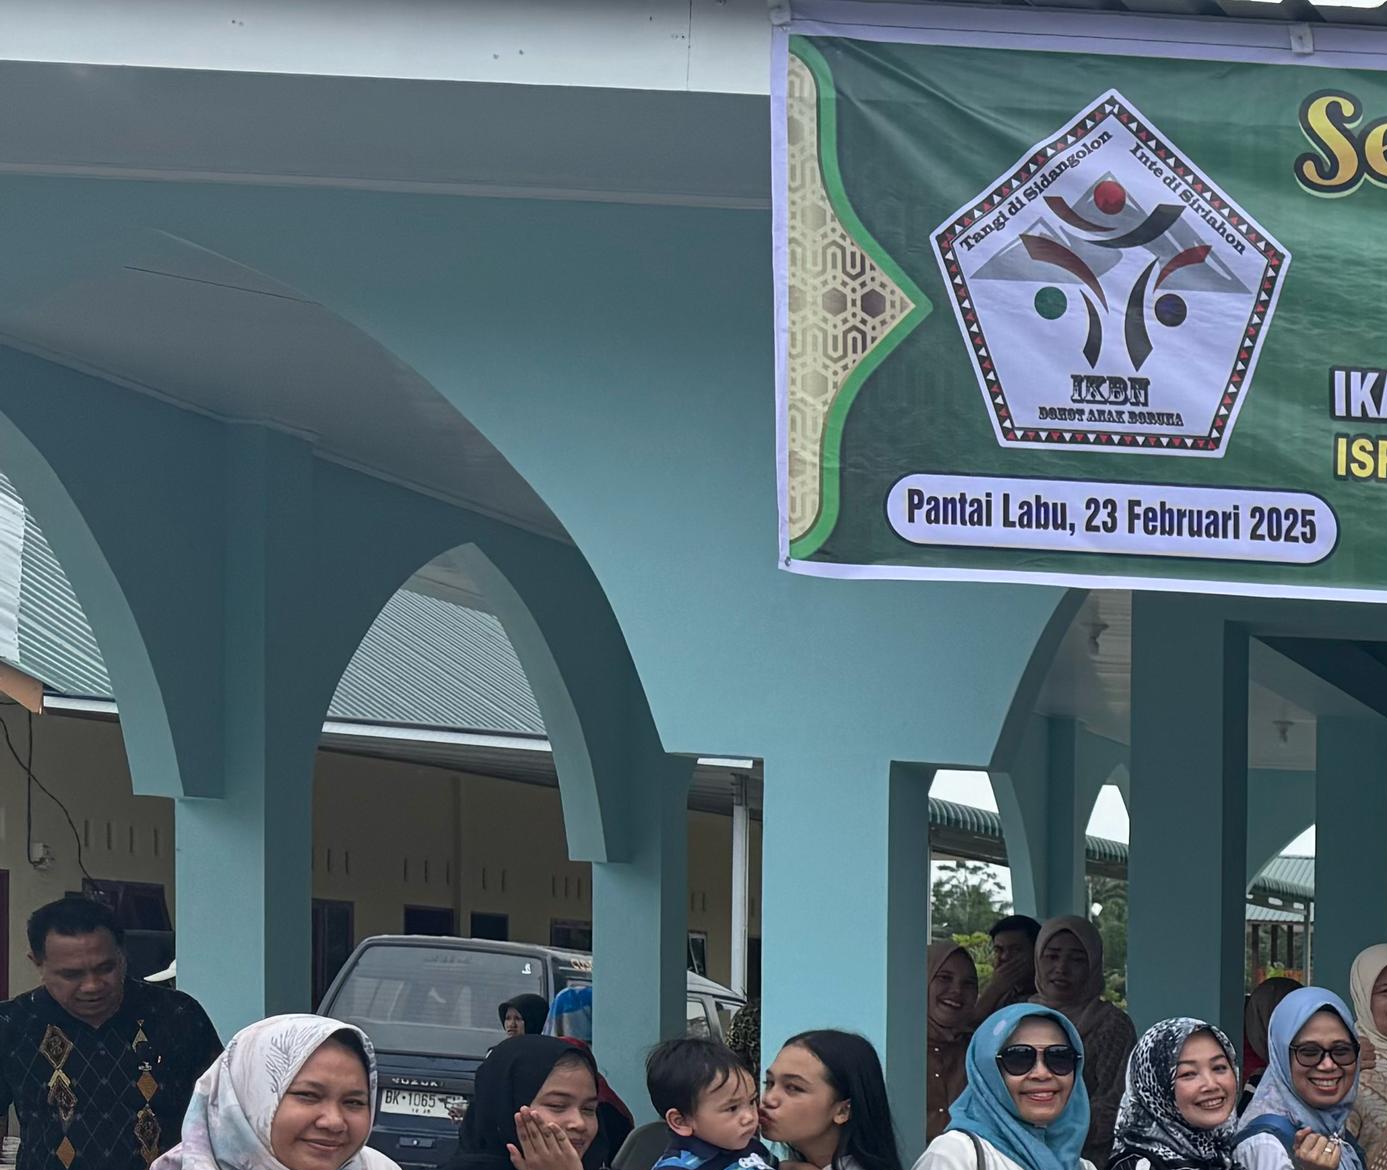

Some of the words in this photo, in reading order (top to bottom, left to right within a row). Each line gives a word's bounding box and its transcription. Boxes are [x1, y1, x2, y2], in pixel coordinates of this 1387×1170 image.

[959, 210, 1010, 251] Tangi
[1007, 196, 1026, 216] di
[1023, 129, 1113, 203] Sidangolon
[1129, 141, 1164, 178] Inte
[1163, 174, 1182, 193] di
[1038, 406, 1085, 422] DOHOT
[1087, 409, 1126, 424] ANAK
[1127, 411, 1185, 427] BORUNA
[1070, 374, 1151, 407] IKBN
[907, 488, 993, 528] Pantai
[1002, 493, 1076, 537] Labu,
[1085, 497, 1118, 533] 23
[1127, 499, 1241, 540] Februari
[1249, 506, 1318, 544] 2025
